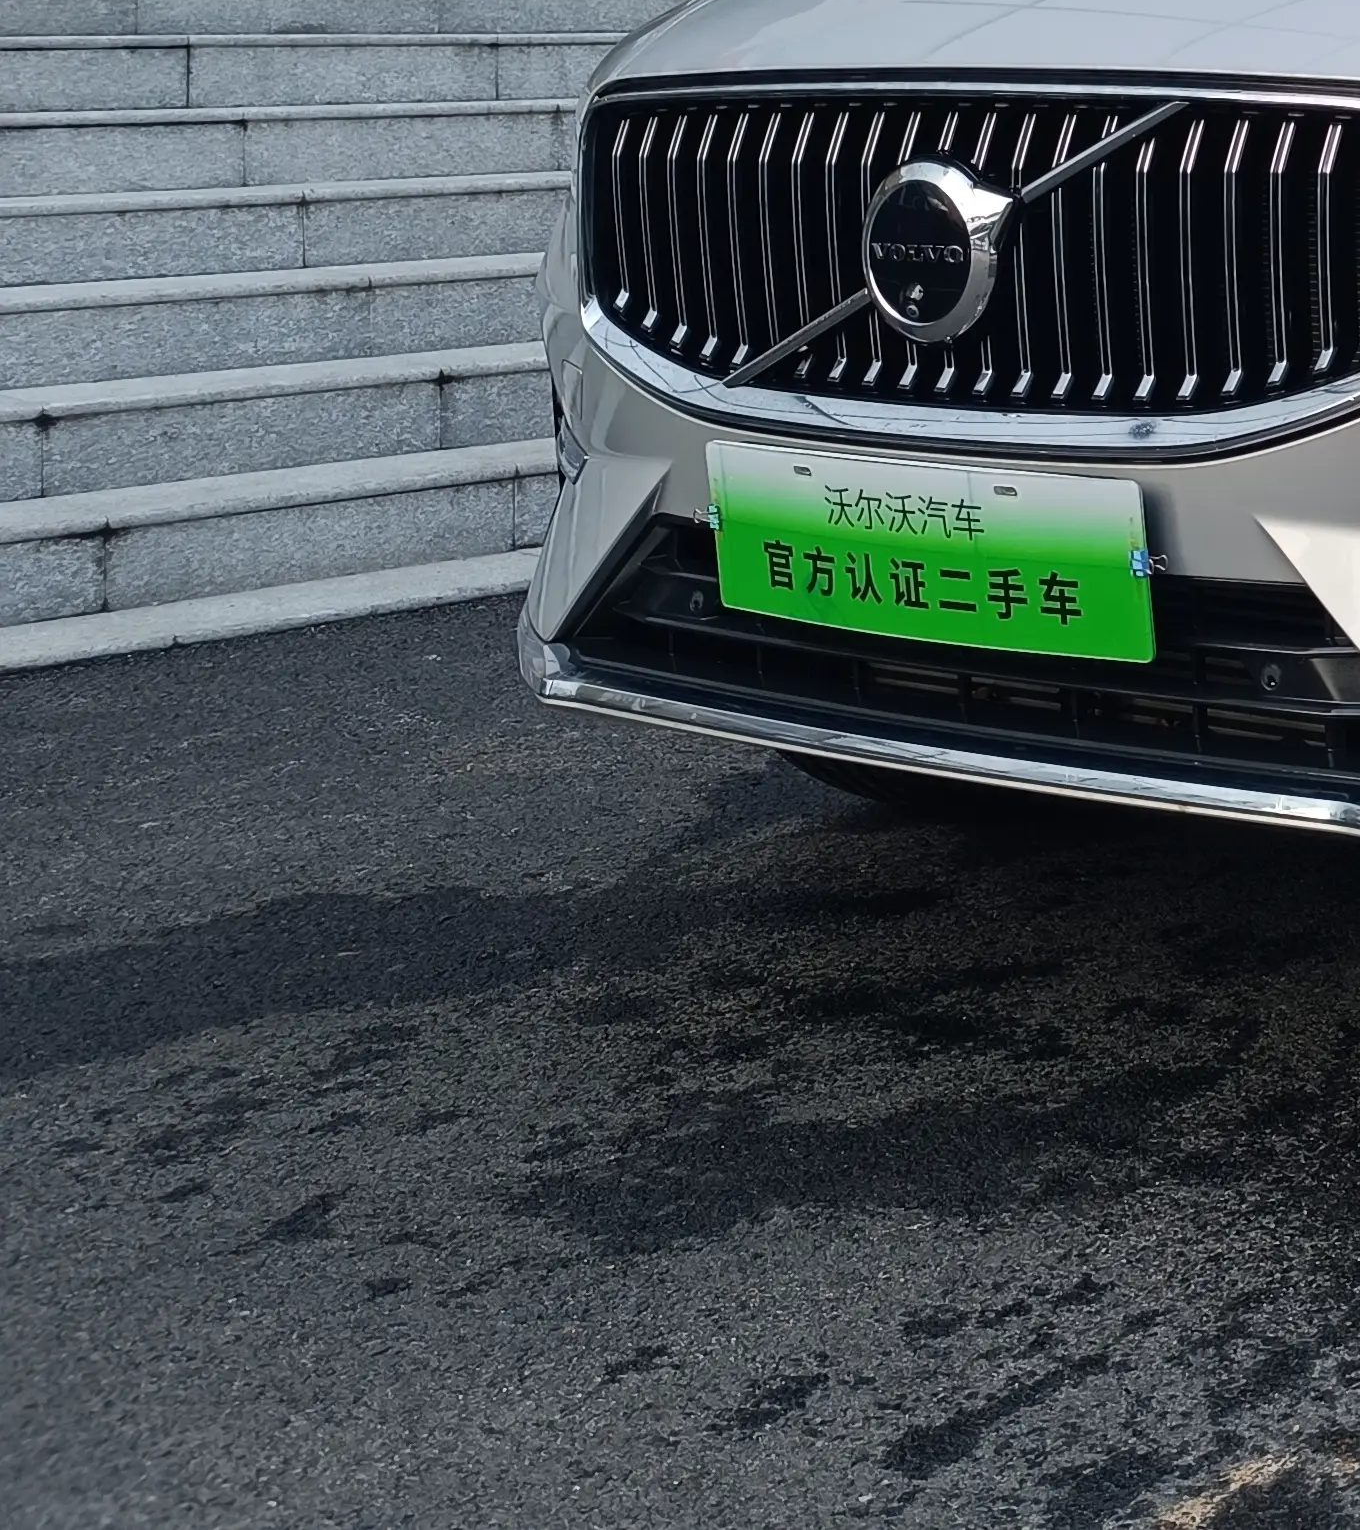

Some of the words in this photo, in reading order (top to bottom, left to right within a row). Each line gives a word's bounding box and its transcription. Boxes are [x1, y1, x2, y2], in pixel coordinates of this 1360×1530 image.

[872, 242, 964, 264] VOLVO
[824, 484, 985, 541] 沃尔沃汽车
[762, 539, 1083, 626] 官方认证二手车
